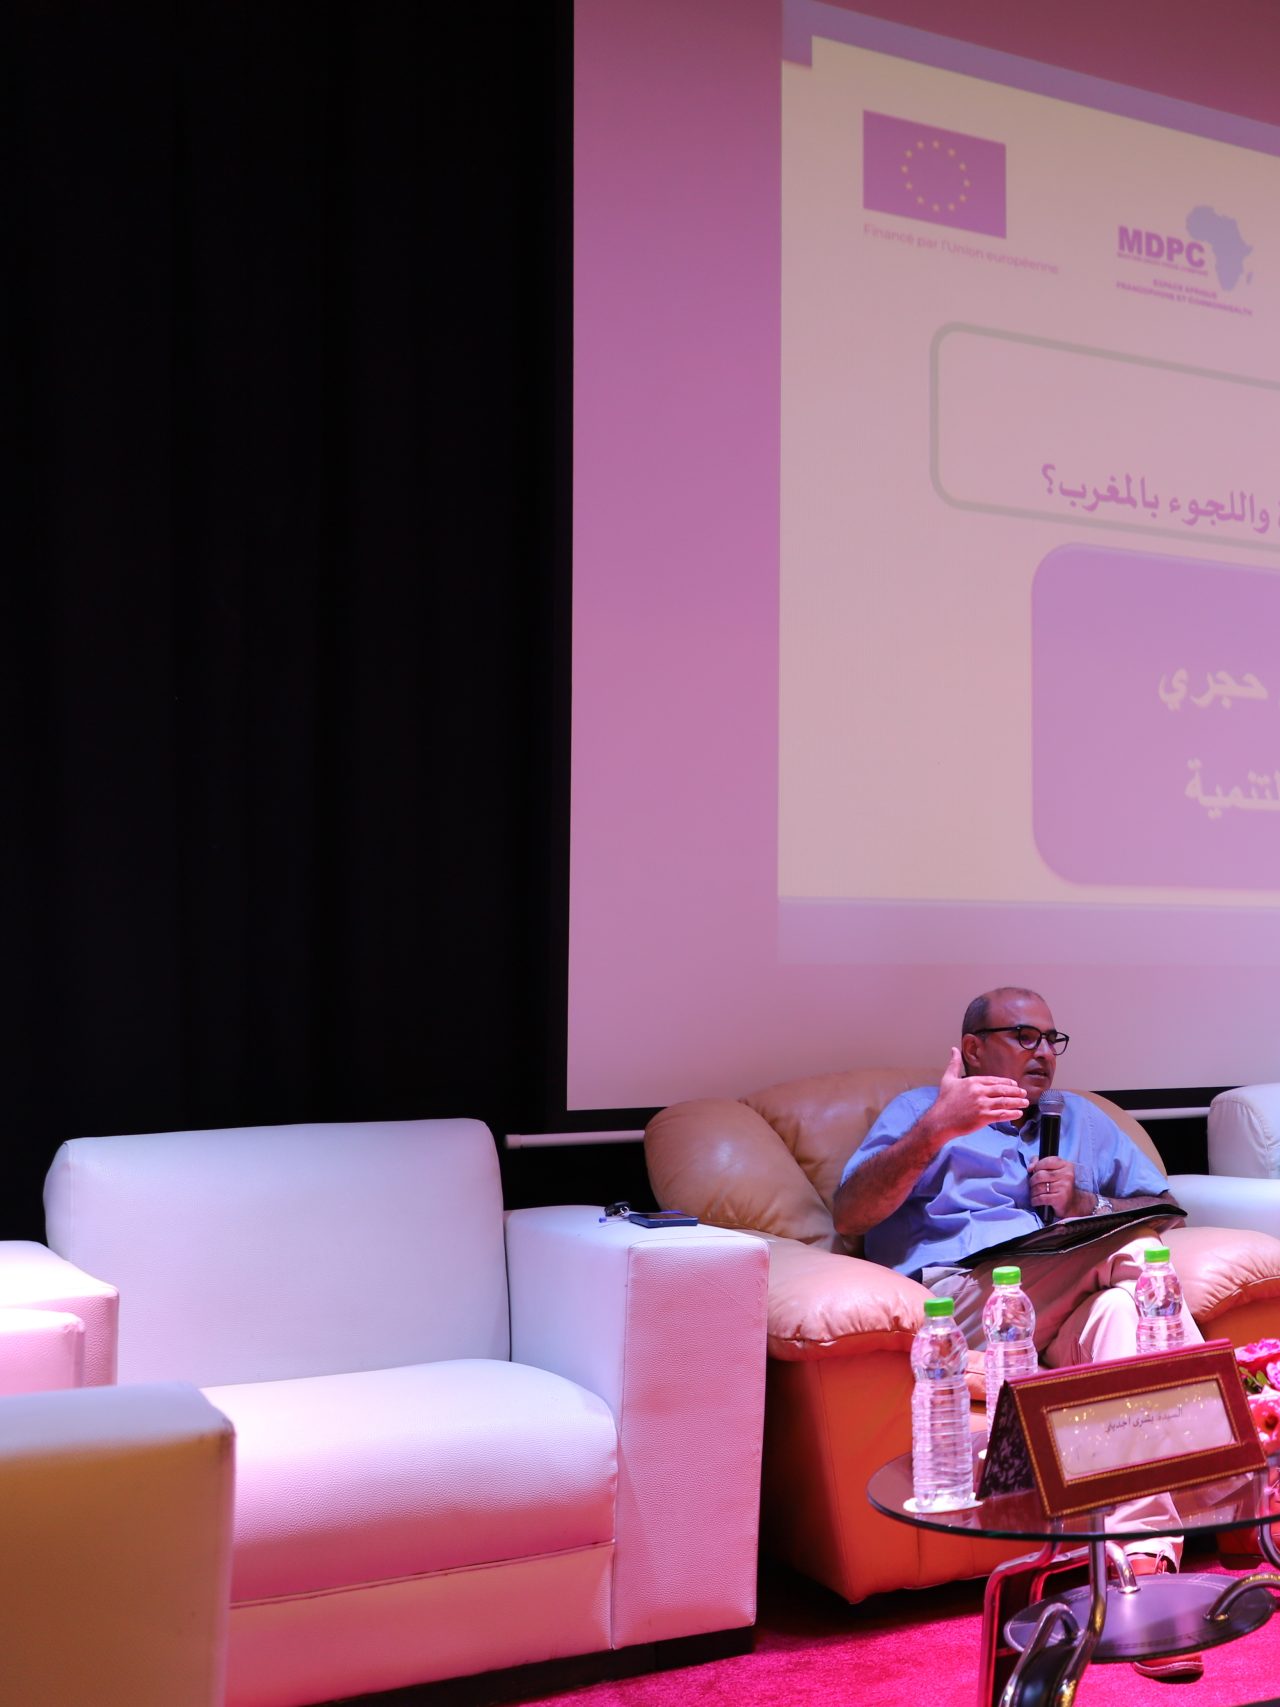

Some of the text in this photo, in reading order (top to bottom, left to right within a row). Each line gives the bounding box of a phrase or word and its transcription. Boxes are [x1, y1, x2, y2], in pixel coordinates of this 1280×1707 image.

[916, 236, 938, 252] par
[1117, 225, 1206, 268] MDPC
[1041, 463, 1160, 518] بالمغرب؟
[1168, 490, 1271, 534] واللجوء
[1157, 665, 1270, 712] حجري
